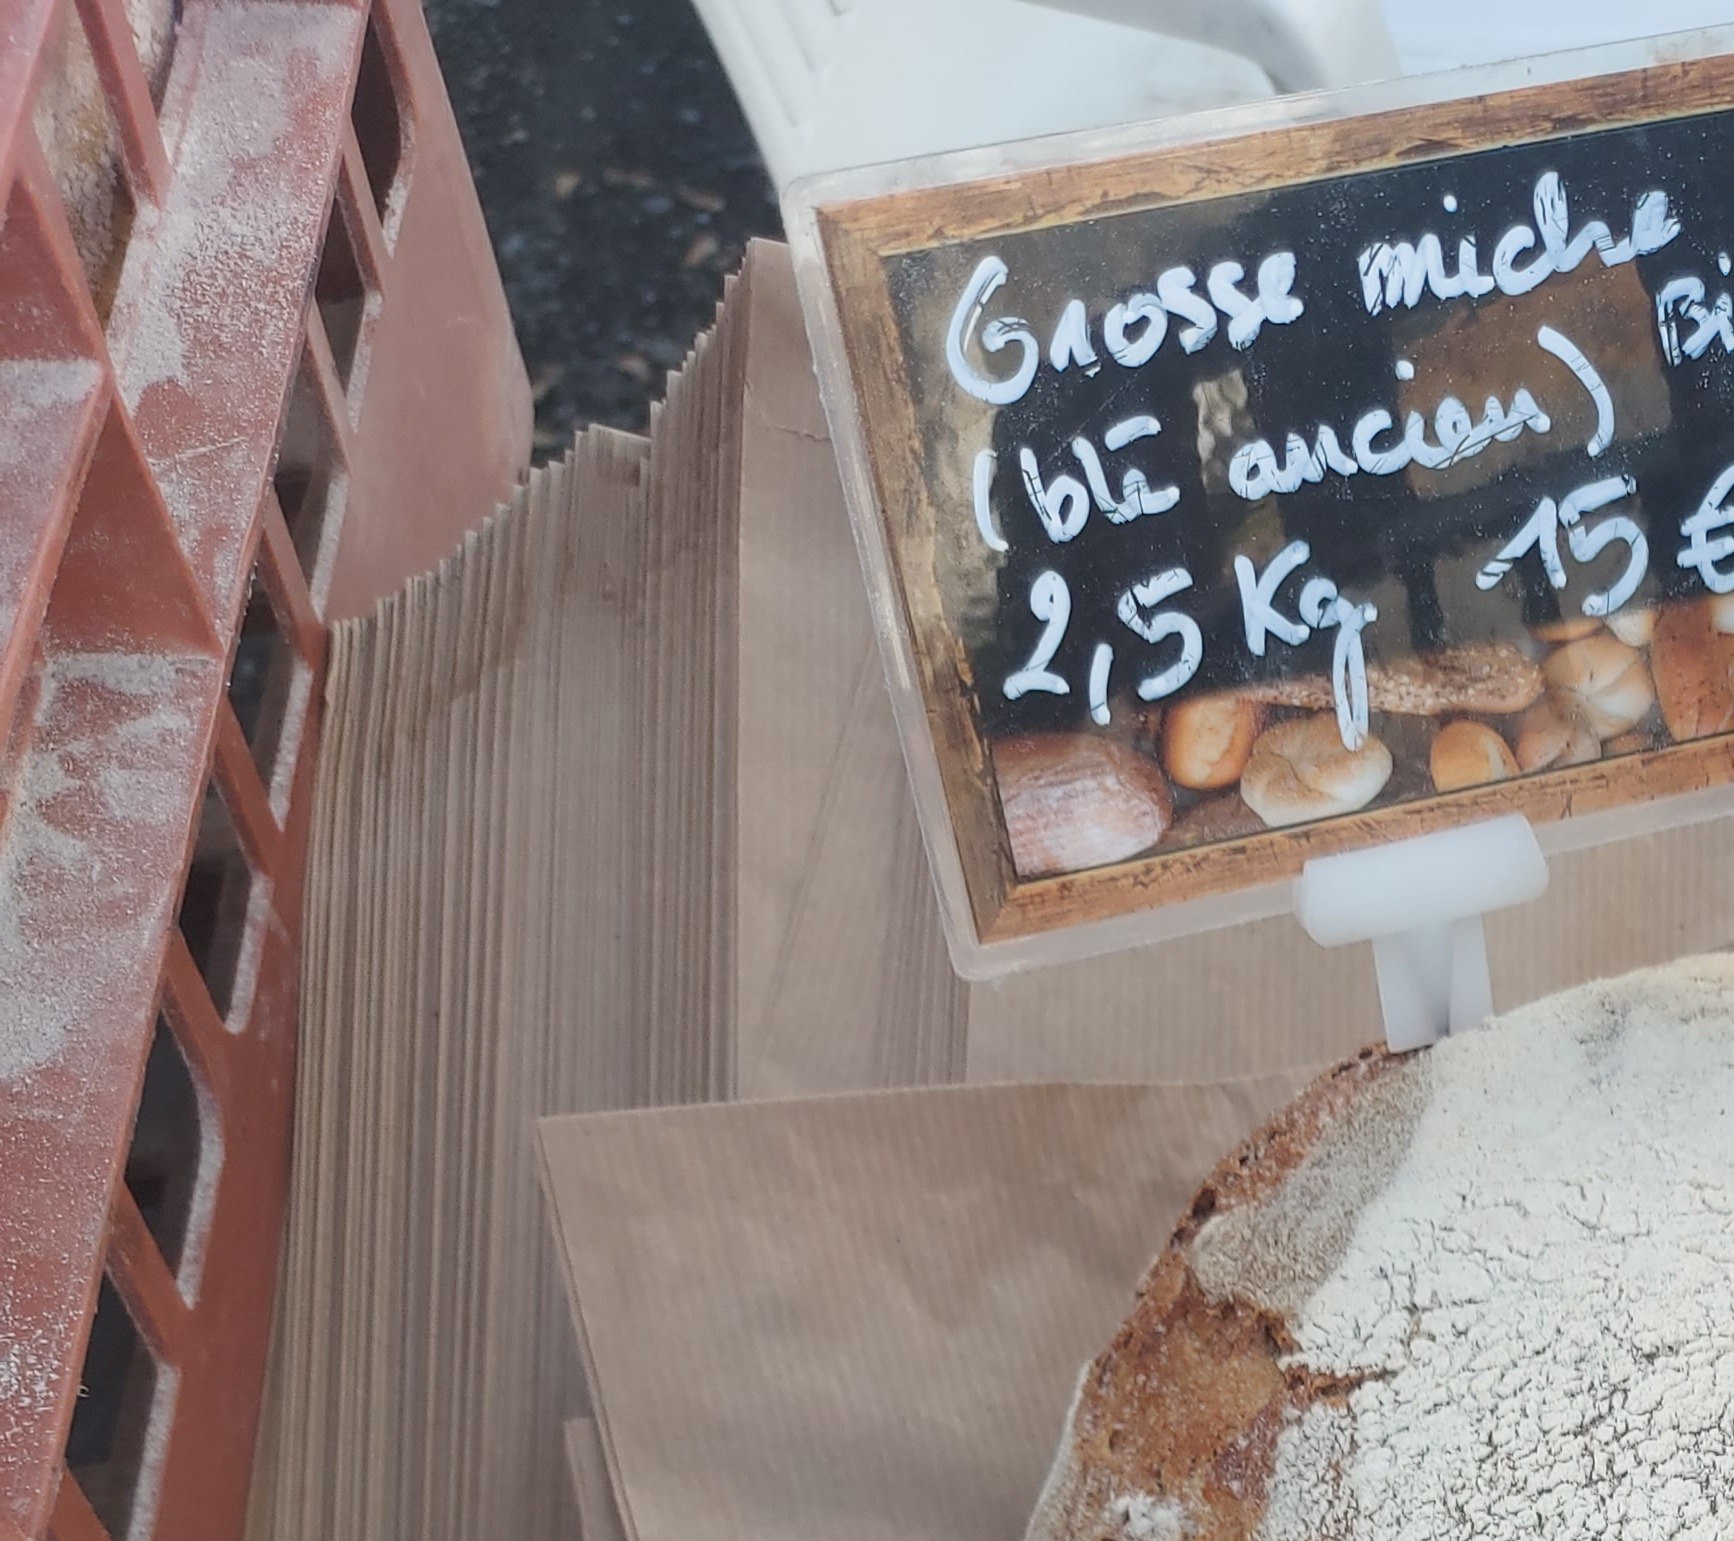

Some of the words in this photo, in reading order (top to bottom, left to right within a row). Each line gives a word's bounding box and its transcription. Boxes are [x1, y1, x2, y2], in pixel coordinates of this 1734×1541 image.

[947, 255, 1303, 404] Grosse
[1359, 172, 1682, 315] miche
[1229, 326, 1614, 499] ancien)
[1004, 569, 1202, 725] 2,5
[1235, 541, 1378, 751] Kg
[1476, 475, 1649, 616] 15
